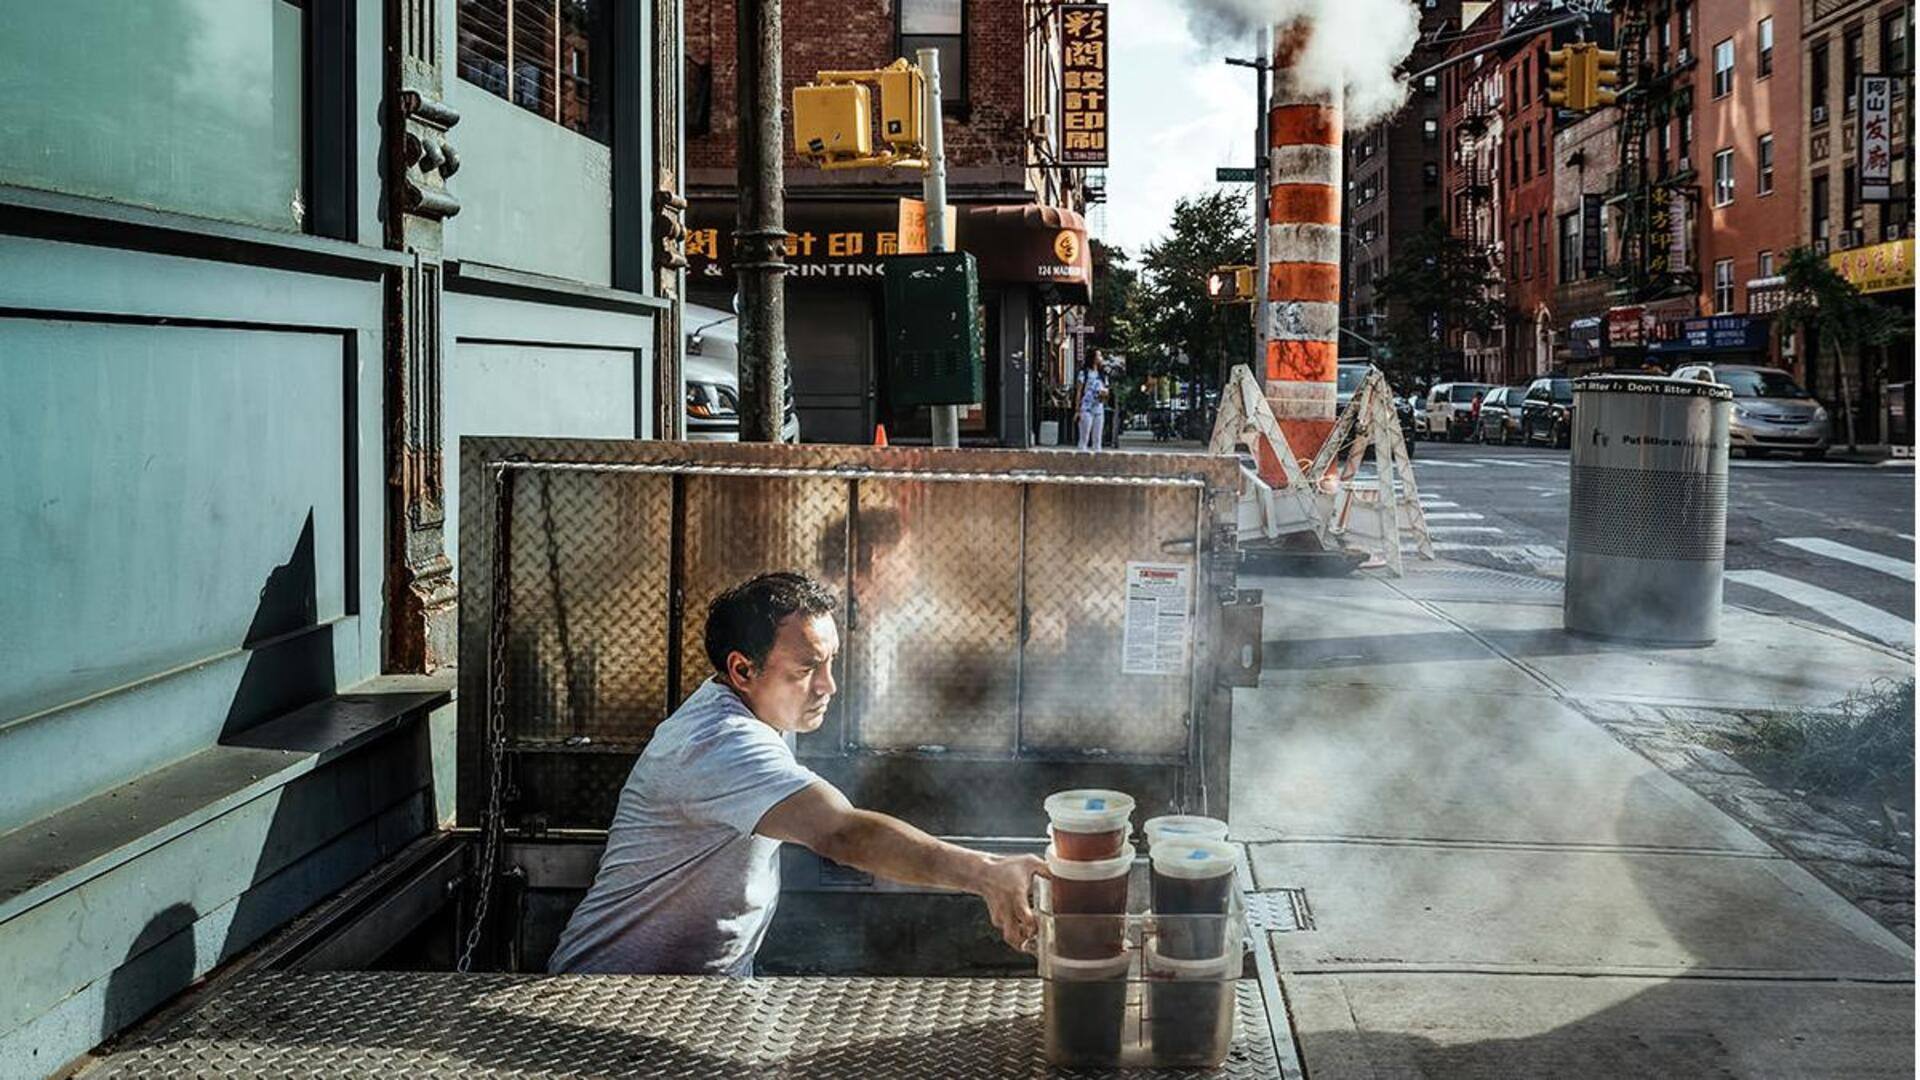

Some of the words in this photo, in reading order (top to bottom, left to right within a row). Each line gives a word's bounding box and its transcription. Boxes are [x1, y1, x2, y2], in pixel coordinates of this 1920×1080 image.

[704, 264, 722, 276] &
[782, 263, 885, 277] RINTIN
[1628, 383, 1662, 393] Don't
[1664, 384, 1691, 395] litter
